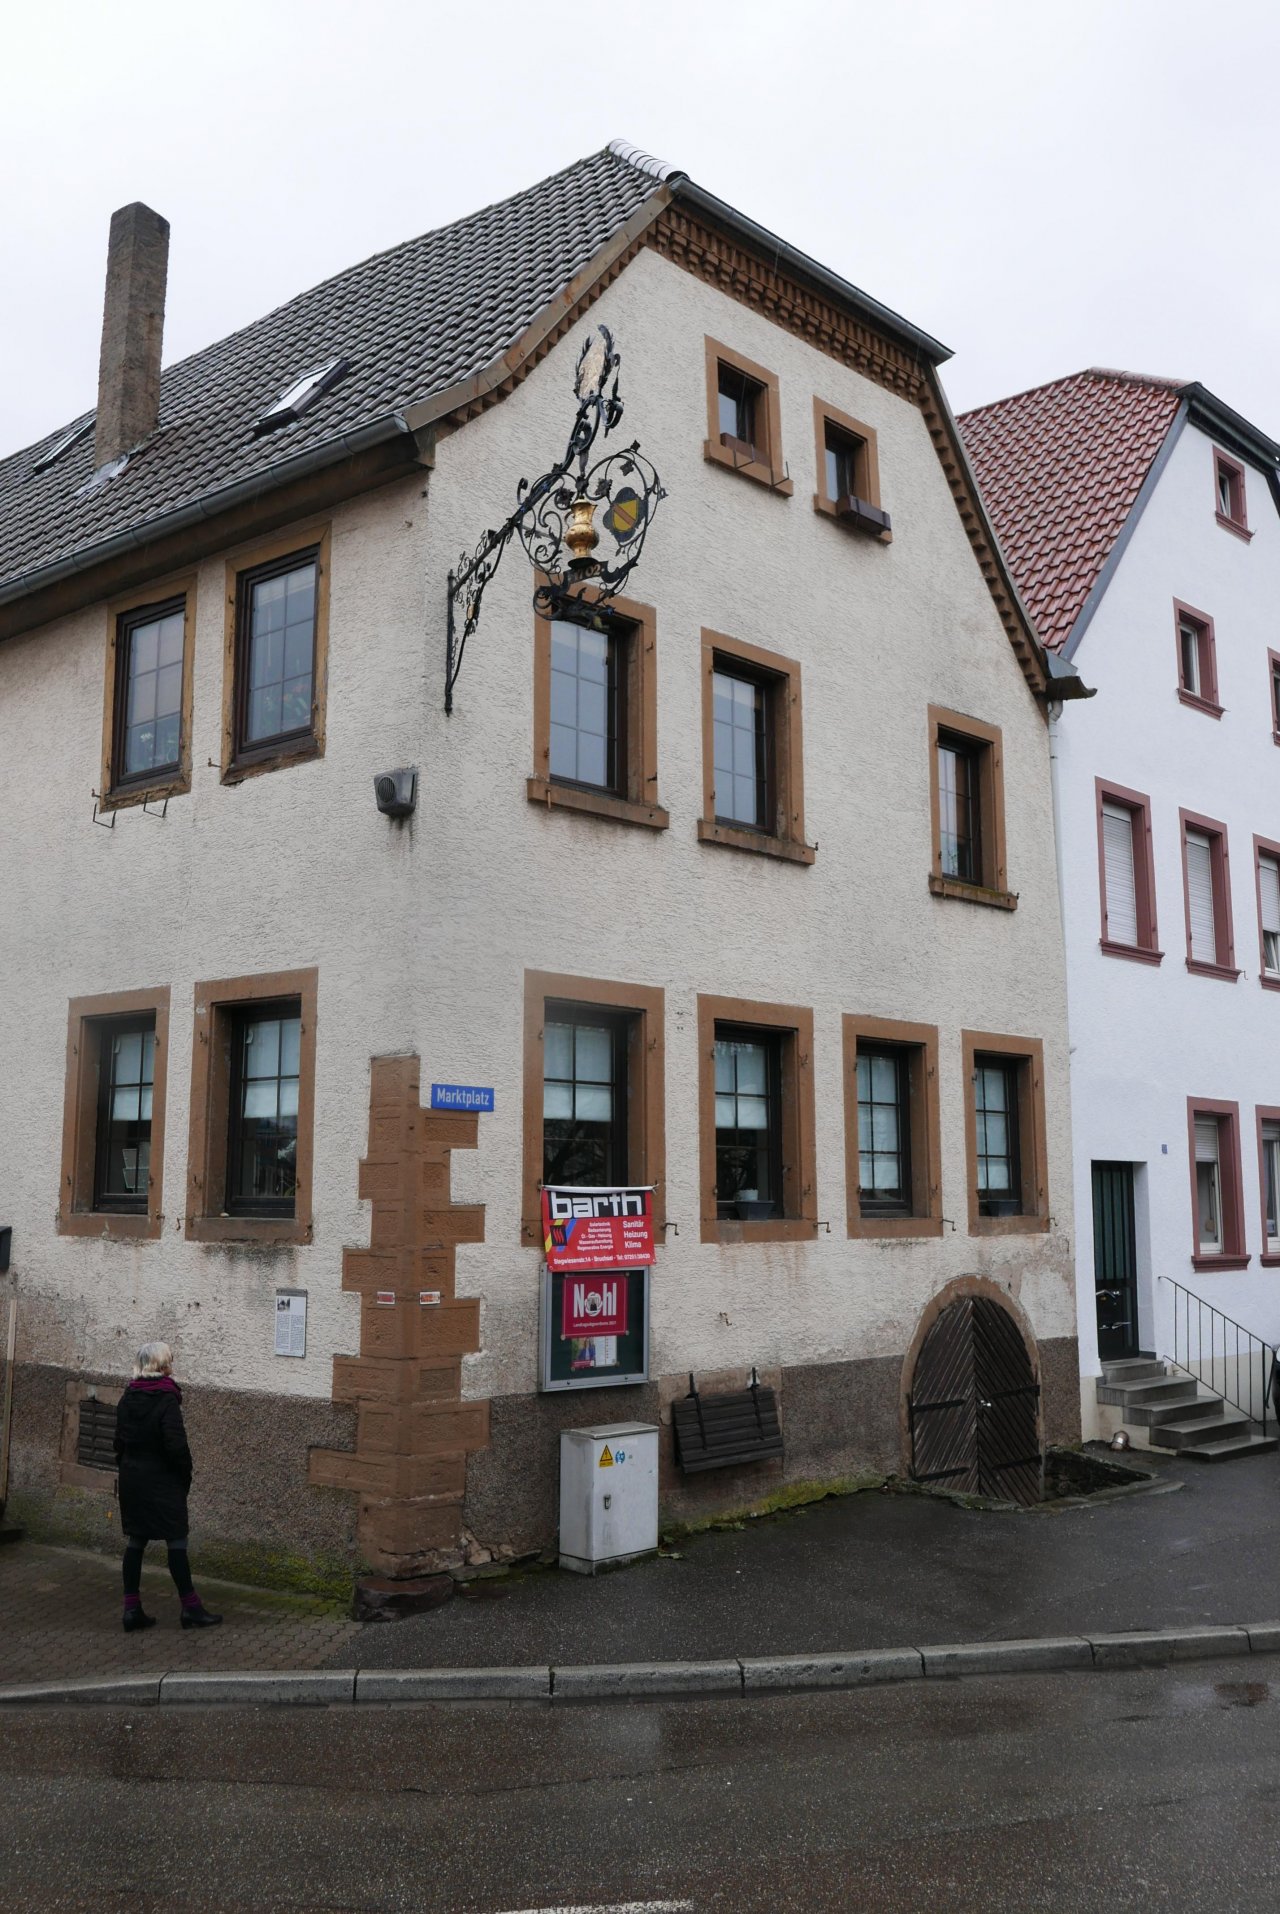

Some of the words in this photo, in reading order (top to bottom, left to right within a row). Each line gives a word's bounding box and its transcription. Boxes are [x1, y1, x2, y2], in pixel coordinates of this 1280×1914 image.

[437, 1087, 490, 1108] Marktplatz
[550, 1191, 642, 1219] barth
[623, 1220, 644, 1228] Sanitär
[624, 1231, 648, 1239] Heizung
[573, 1283, 617, 1318] Nohl
